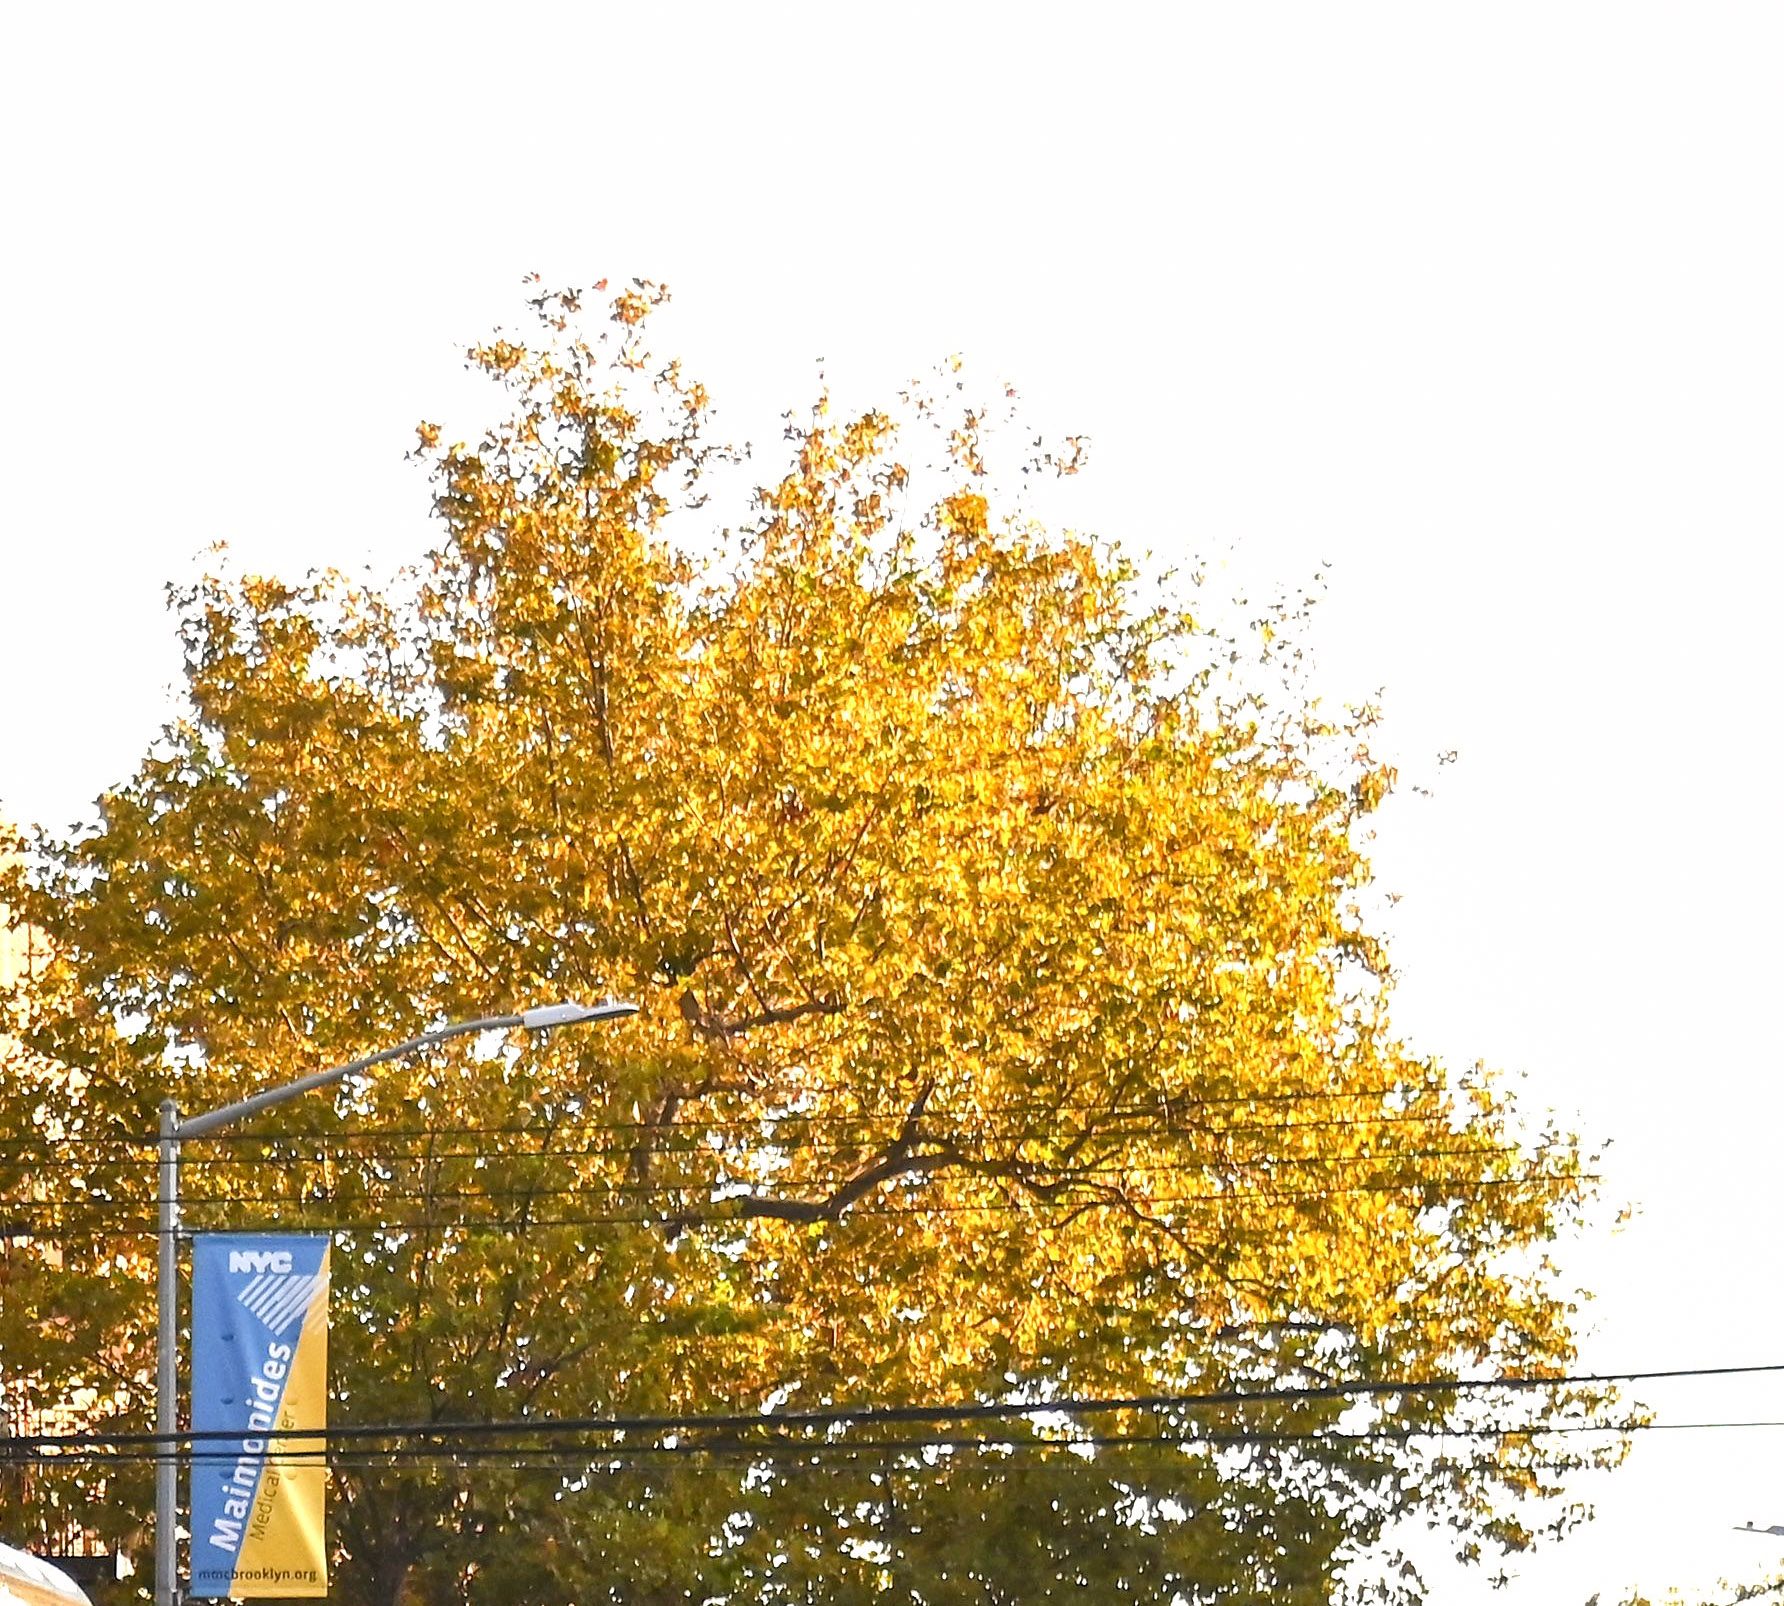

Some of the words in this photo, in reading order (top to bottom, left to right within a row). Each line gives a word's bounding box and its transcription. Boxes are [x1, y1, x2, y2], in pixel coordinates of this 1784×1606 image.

[229, 1251, 293, 1274] NYC
[208, 1340, 292, 1552] Maimonides
[249, 1466, 281, 1541] Medical
[198, 1568, 318, 1583] mmcbrooklyn.org
